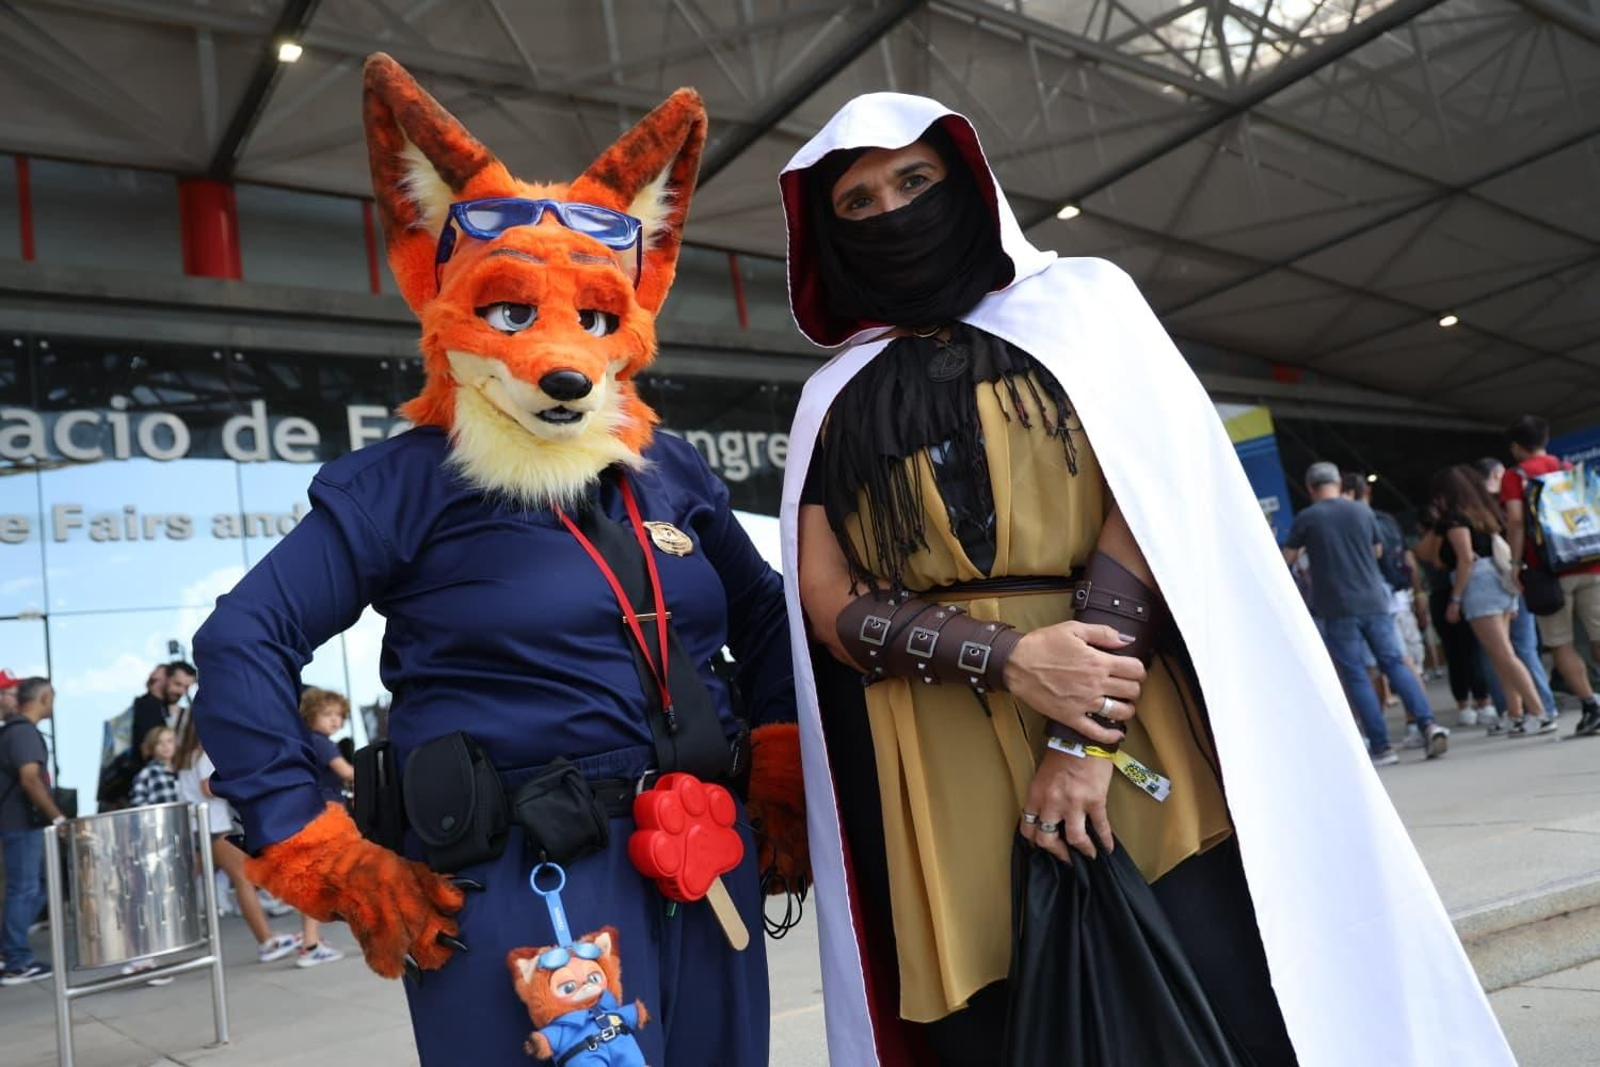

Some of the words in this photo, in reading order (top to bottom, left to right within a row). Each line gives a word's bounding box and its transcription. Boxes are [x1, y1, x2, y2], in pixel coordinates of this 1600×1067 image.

[222, 400, 319, 461] de
[658, 429, 790, 481] ngre
[51, 503, 193, 542] Fairs
